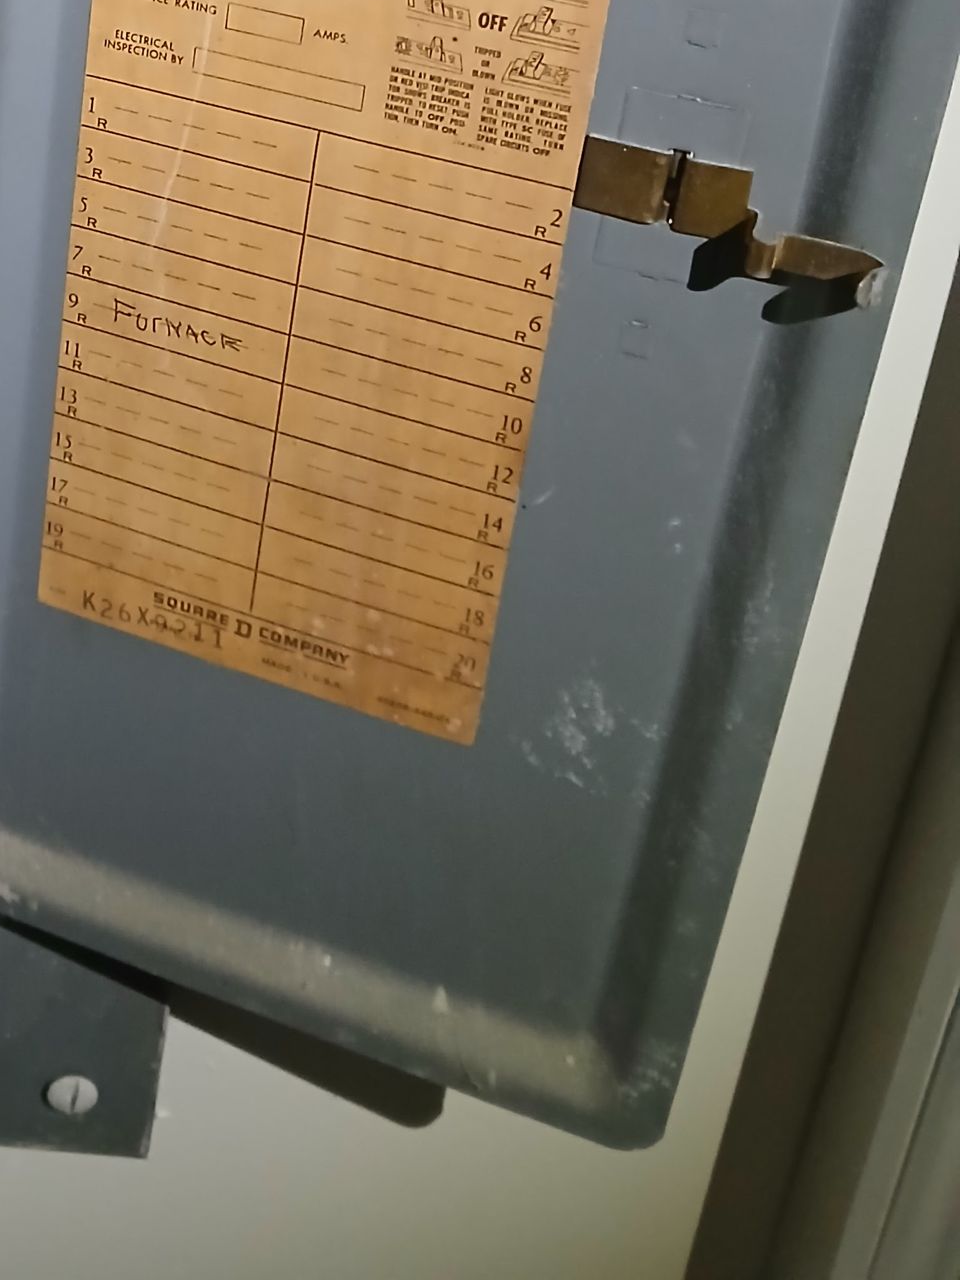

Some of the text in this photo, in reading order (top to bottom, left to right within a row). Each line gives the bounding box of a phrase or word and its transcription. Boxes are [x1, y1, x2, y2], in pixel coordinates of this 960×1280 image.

[478, 12, 508, 32] OFF
[114, 29, 175, 52] ELECTRICAL
[313, 28, 349, 44] AMPS.
[104, 38, 184, 65] INSPECTION BY
[88, 96, 96, 114] 1
[97, 118, 108, 129] R
[85, 147, 94, 164] 3
[92, 168, 103, 179] R
[78, 197, 88, 213] 5
[86, 217, 98, 228] R
[550, 208, 564, 228] 2
[534, 226, 547, 238] R
[72, 245, 84, 261] 7
[82, 265, 92, 276] R
[540, 262, 552, 281] 4
[524, 278, 536, 290] R
[68, 293, 78, 308] 9
[77, 312, 87, 324] R
[530, 316, 542, 332] 6
[514, 330, 526, 342] R
[64, 340, 80, 358] 11
[72, 359, 82, 371] R
[520, 366, 533, 384] 8
[60, 386, 78, 405] 13
[500, 414, 523, 436] 10
[56, 431, 72, 450] 15
[492, 464, 514, 485] 12
[51, 476, 68, 493] 17
[46, 521, 64, 538] 19
[483, 513, 504, 533] 14
[474, 560, 494, 580] 16
[464, 608, 484, 627] 18
[153, 591, 350, 665] SQUARE D COMPANY
